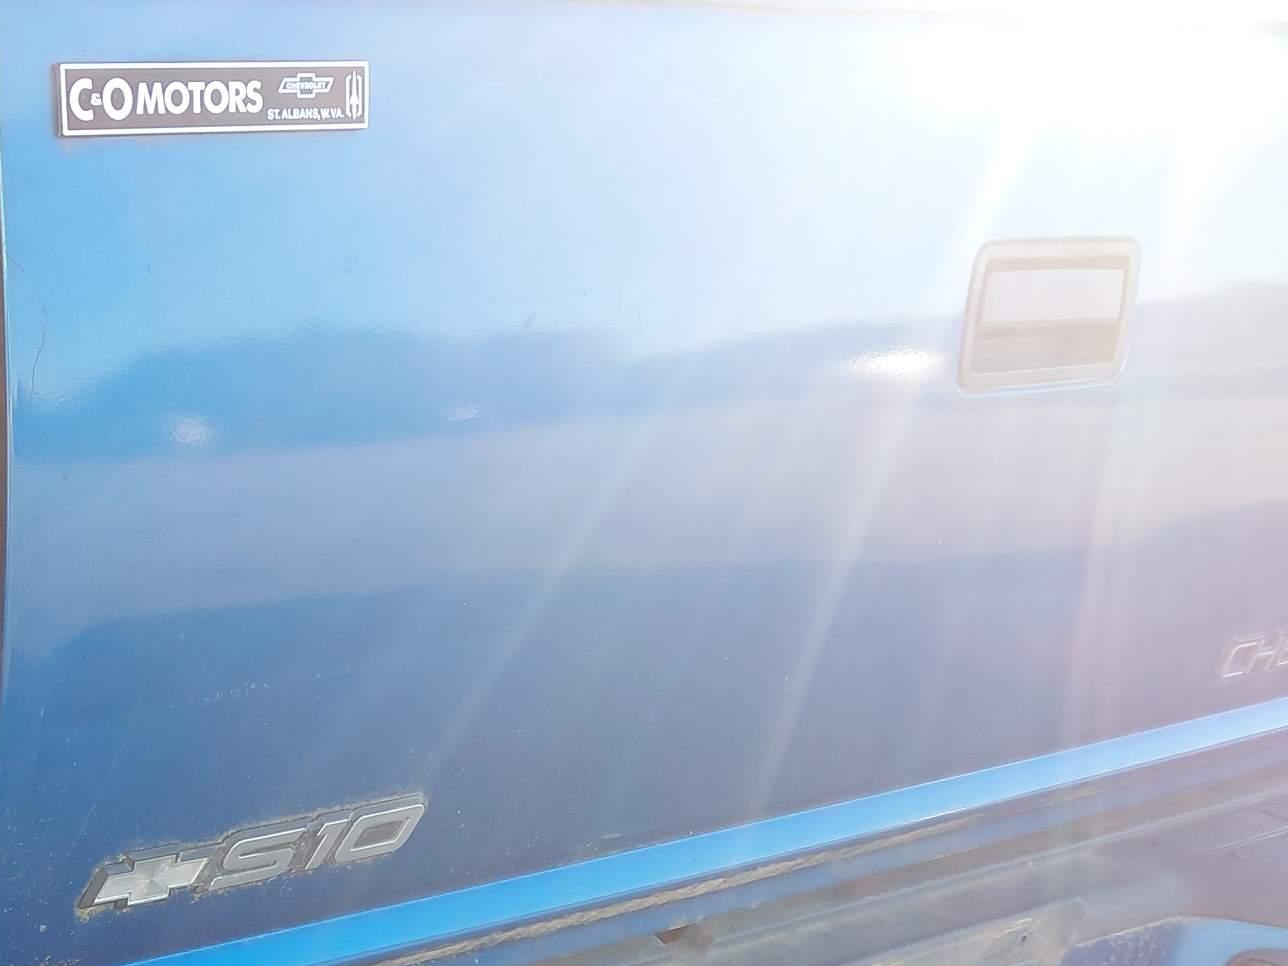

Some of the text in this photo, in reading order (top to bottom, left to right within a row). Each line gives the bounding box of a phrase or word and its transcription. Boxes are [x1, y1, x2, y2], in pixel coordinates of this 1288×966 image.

[69, 77, 263, 121] C&O MOTORS
[285, 81, 327, 90] CHEVROLET
[210, 802, 425, 890] S10
